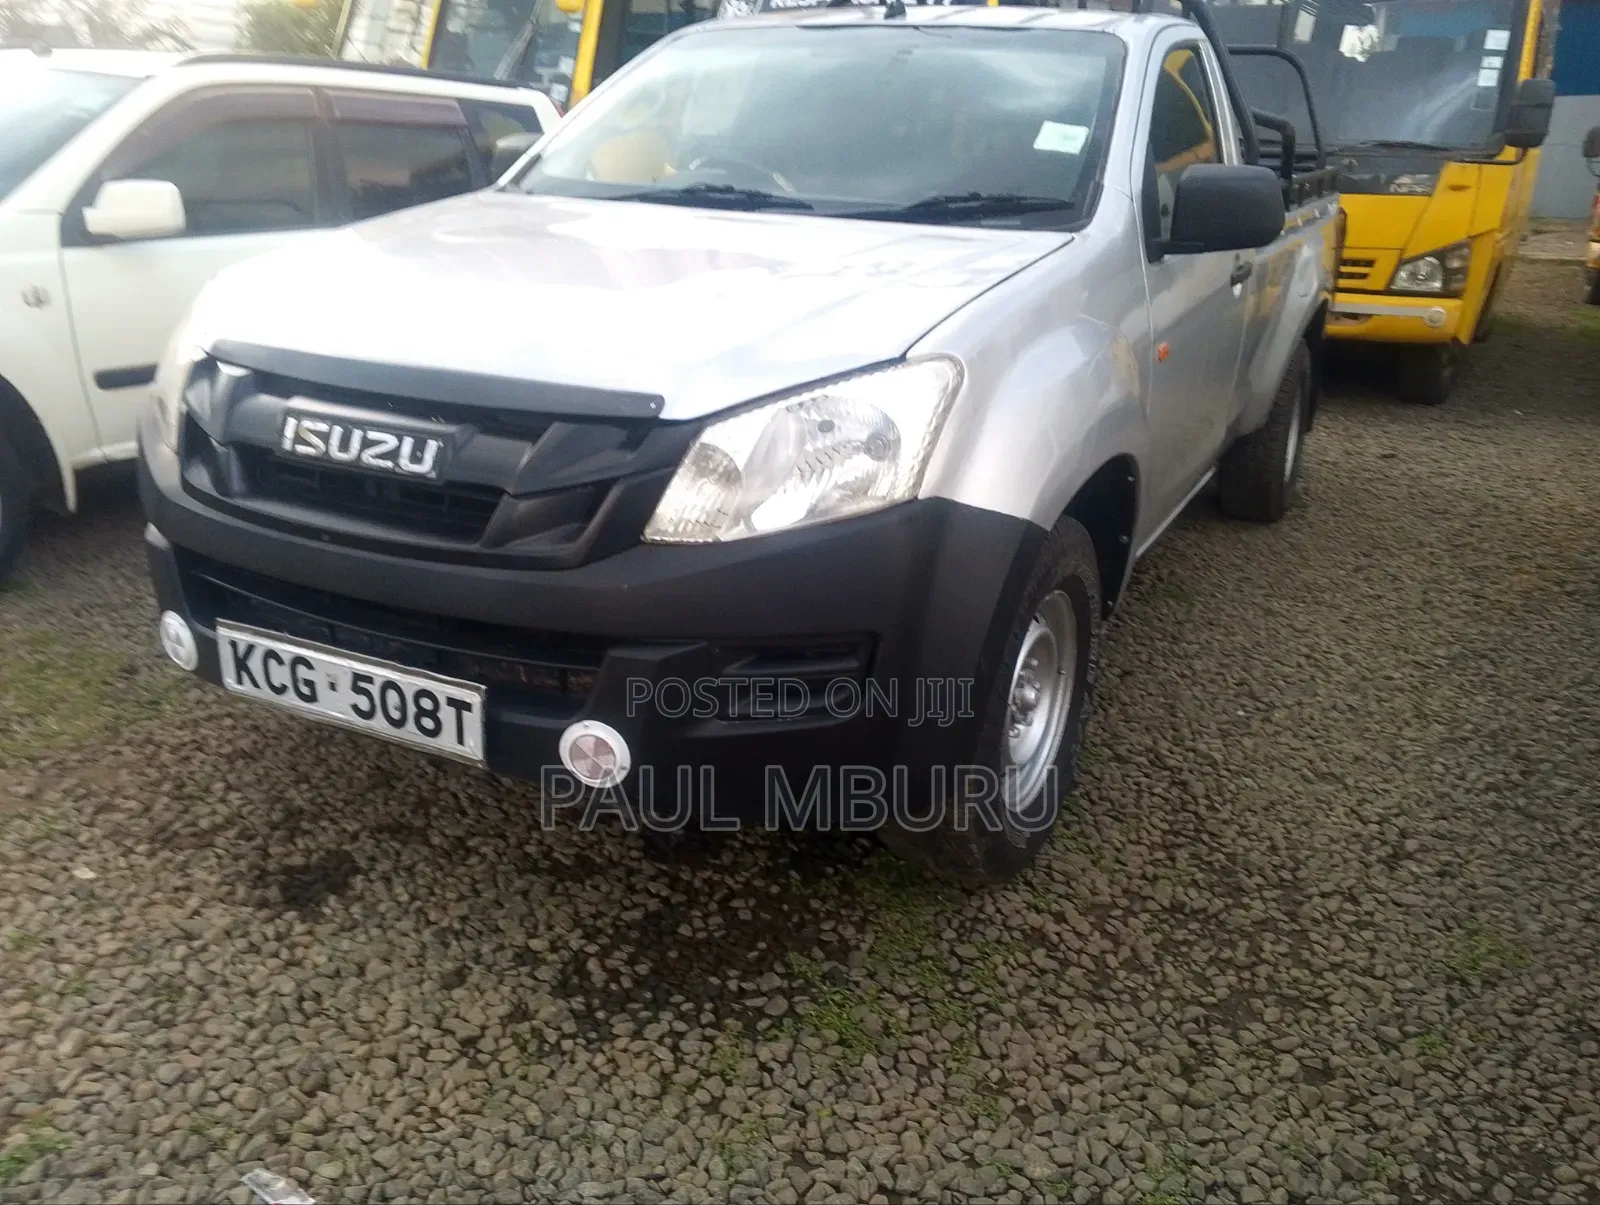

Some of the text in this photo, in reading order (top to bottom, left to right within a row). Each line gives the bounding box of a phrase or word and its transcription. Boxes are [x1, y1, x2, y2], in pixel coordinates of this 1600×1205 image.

[281, 416, 439, 476] ISUZU
[229, 639, 473, 746] KCG 508T
